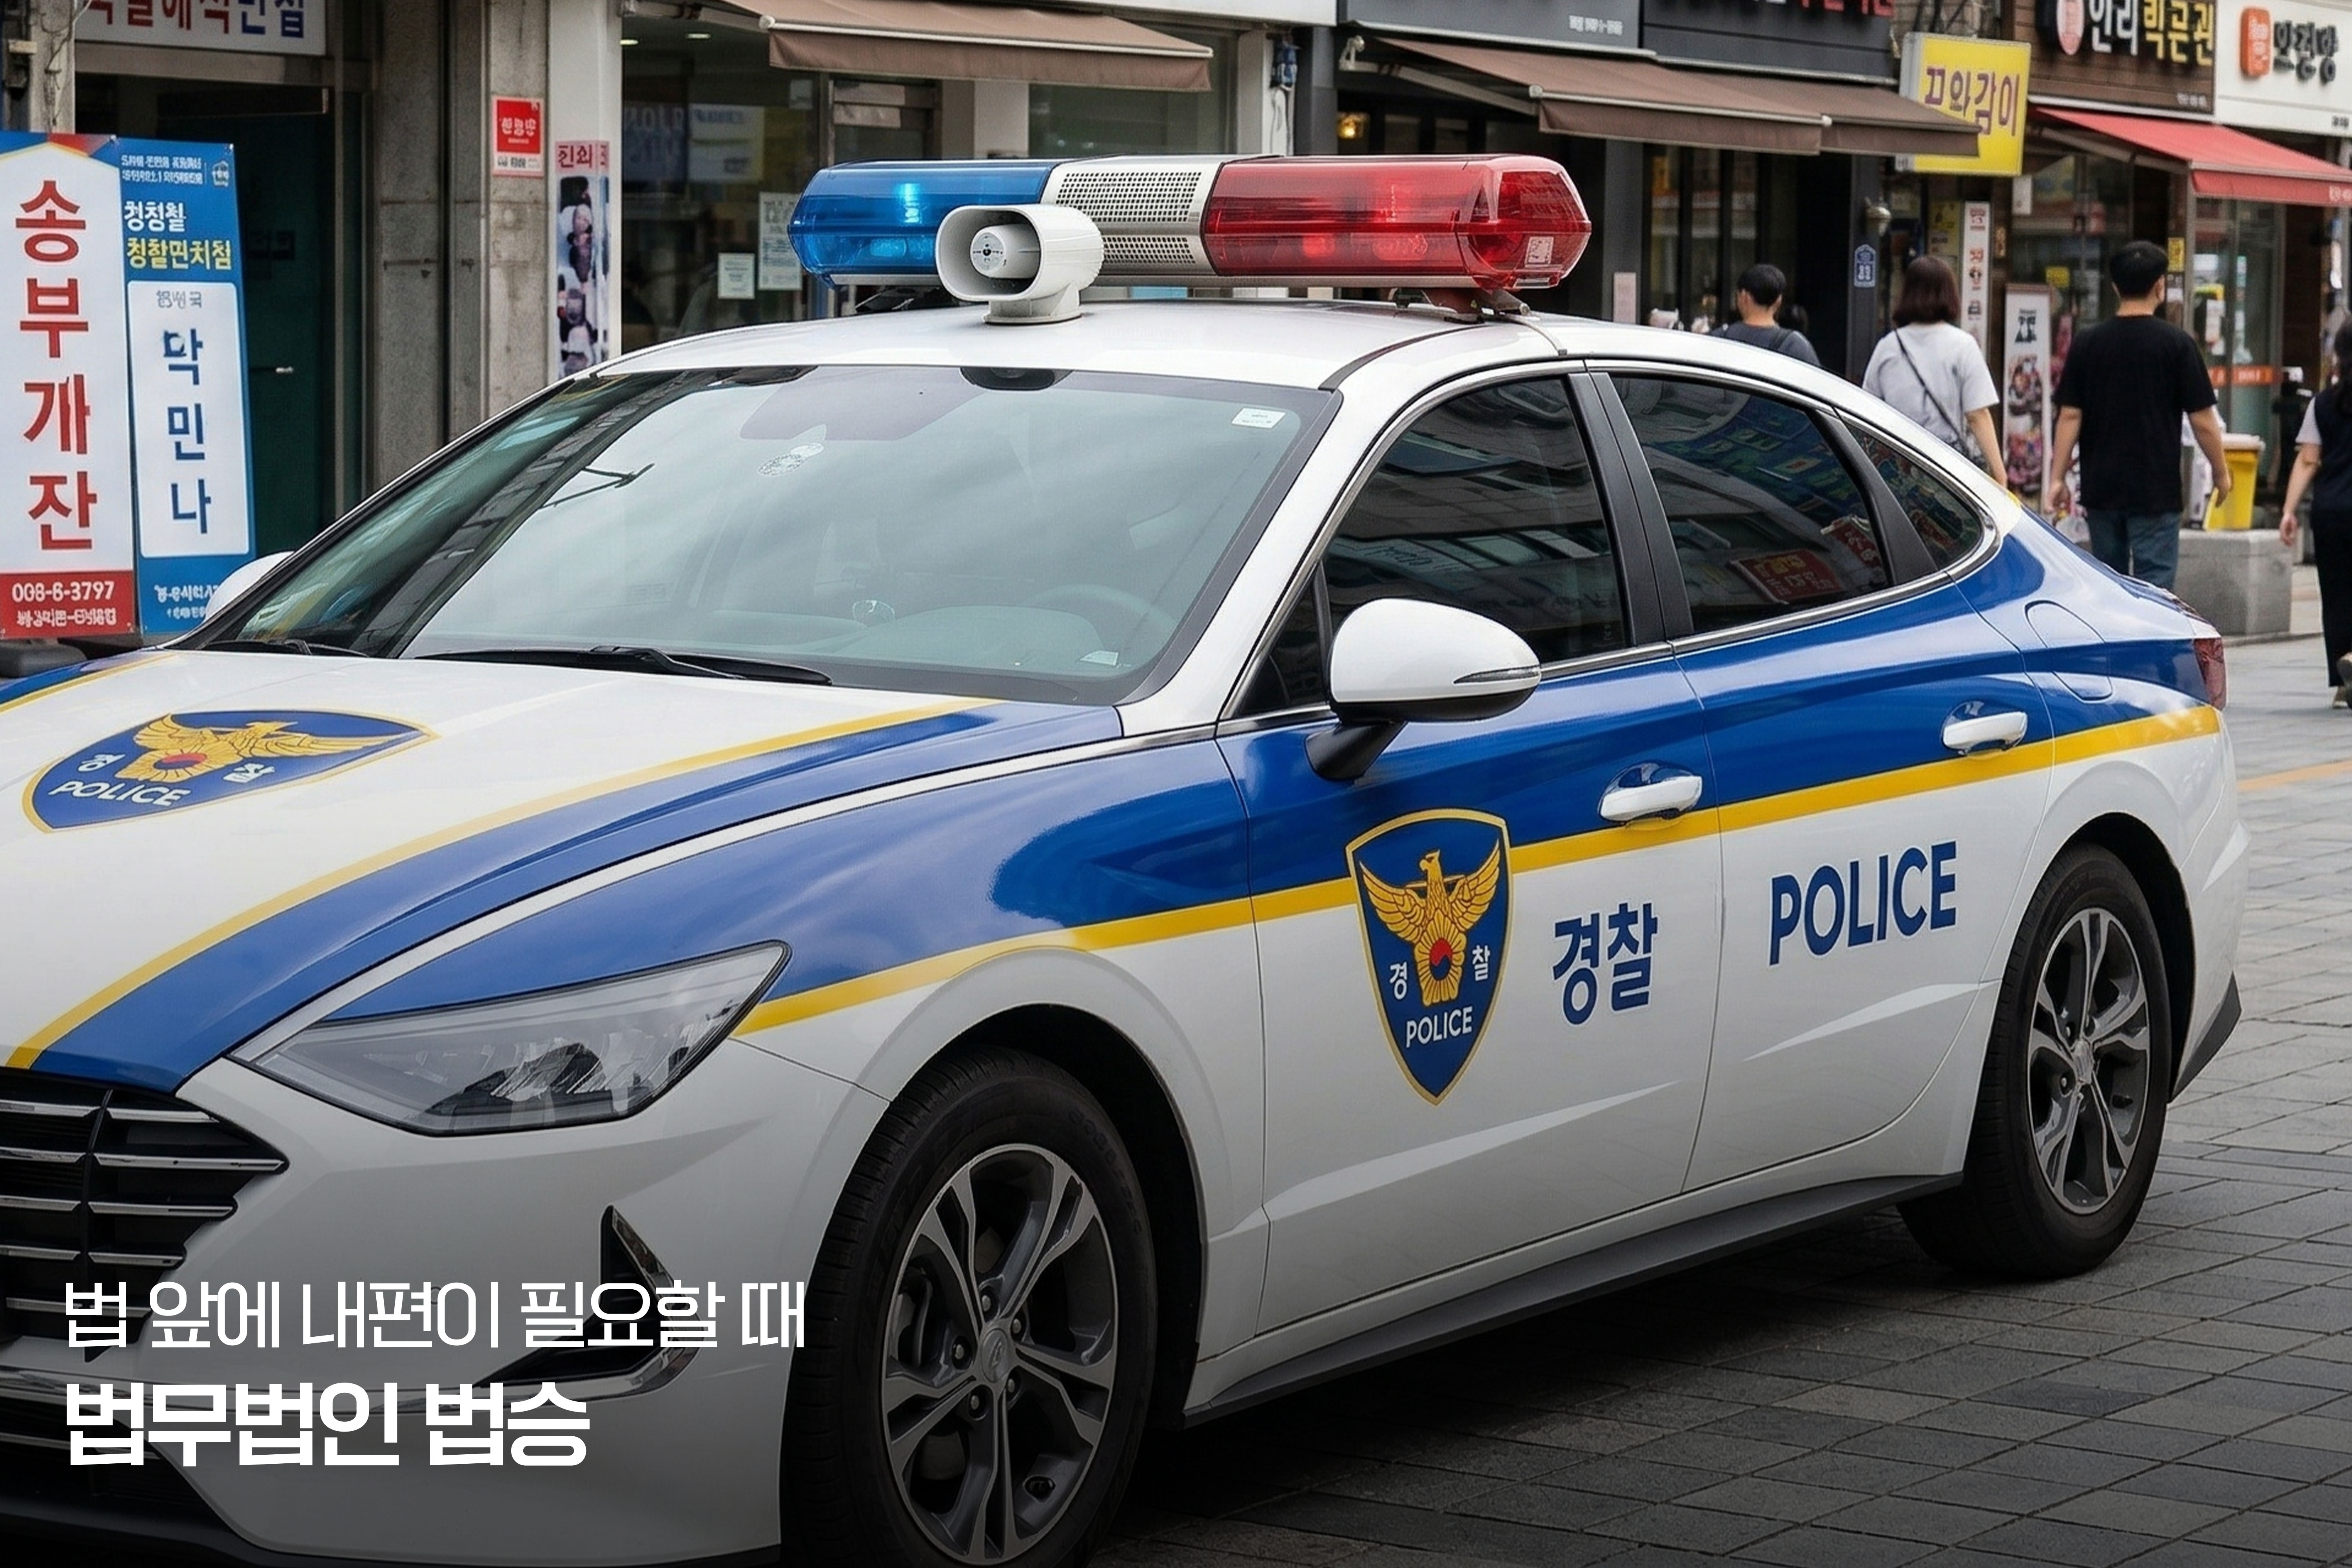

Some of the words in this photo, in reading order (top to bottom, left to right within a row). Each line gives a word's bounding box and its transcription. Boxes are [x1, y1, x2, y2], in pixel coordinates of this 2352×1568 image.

[49, 780, 193, 808] POLICE
[1769, 841, 1956, 965] POLICE
[1389, 962, 1408, 1000] 경
[1472, 945, 1490, 982] 찰
[1552, 902, 1658, 1025] 경찰
[1406, 1006, 1473, 1048] POLICE
